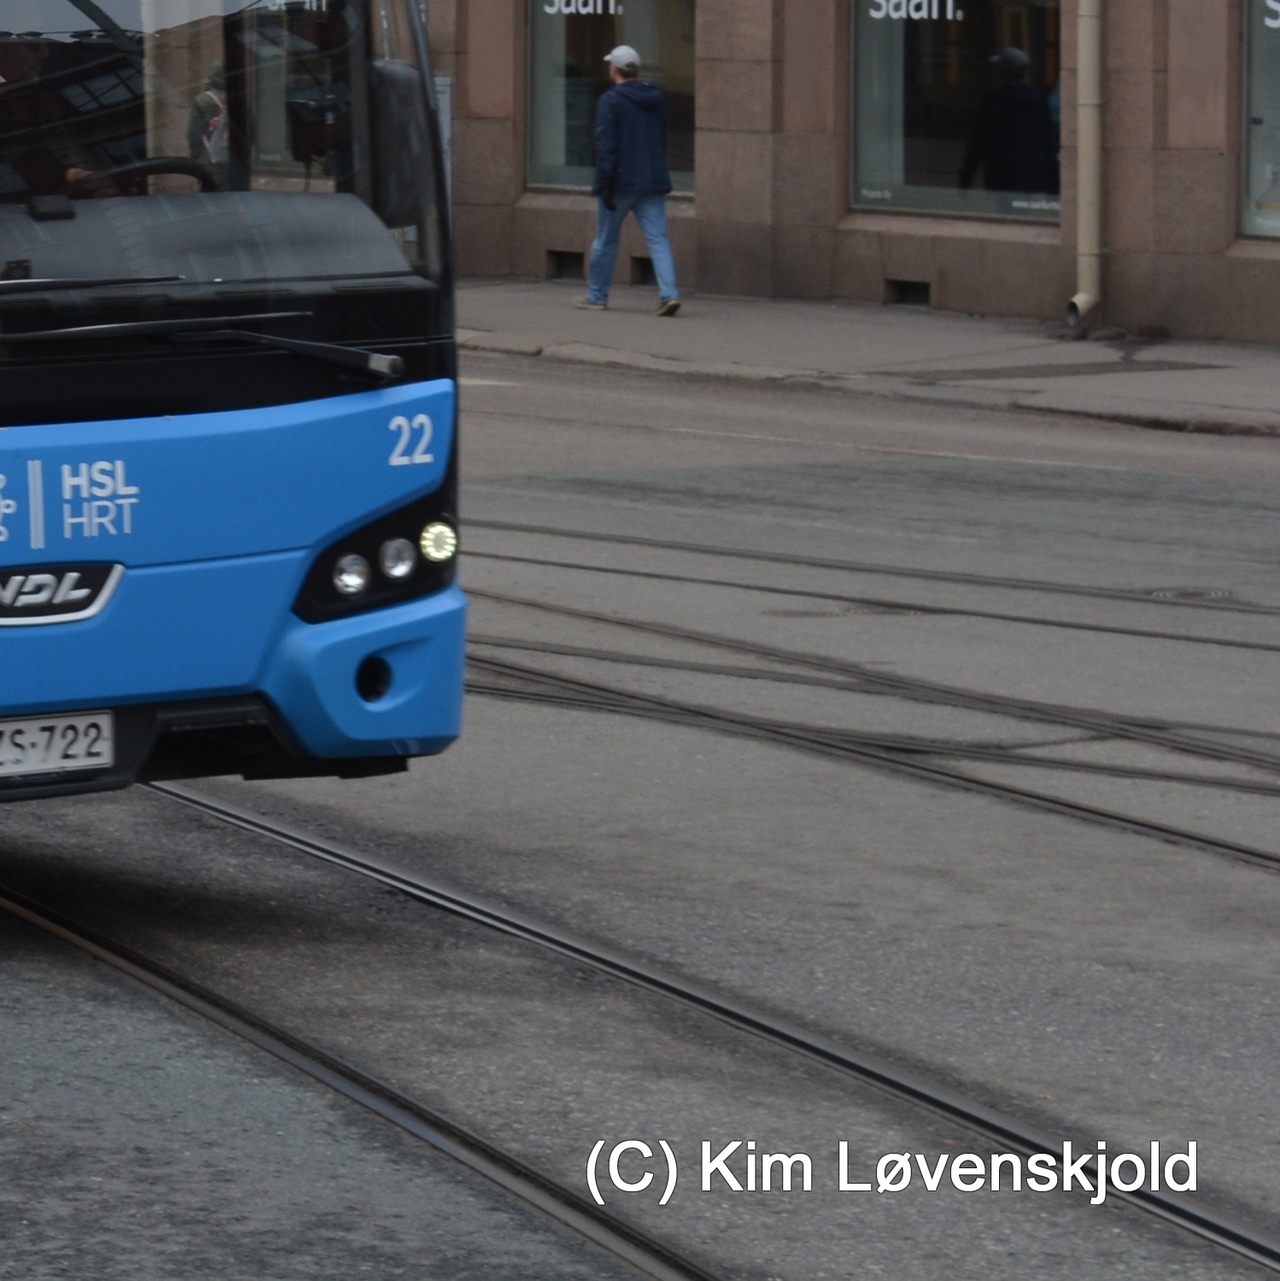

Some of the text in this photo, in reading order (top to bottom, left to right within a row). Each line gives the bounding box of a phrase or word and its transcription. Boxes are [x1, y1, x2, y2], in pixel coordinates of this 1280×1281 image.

[387, 413, 435, 467] 22
[61, 459, 140, 500] HSL
[62, 498, 140, 539] HRT
